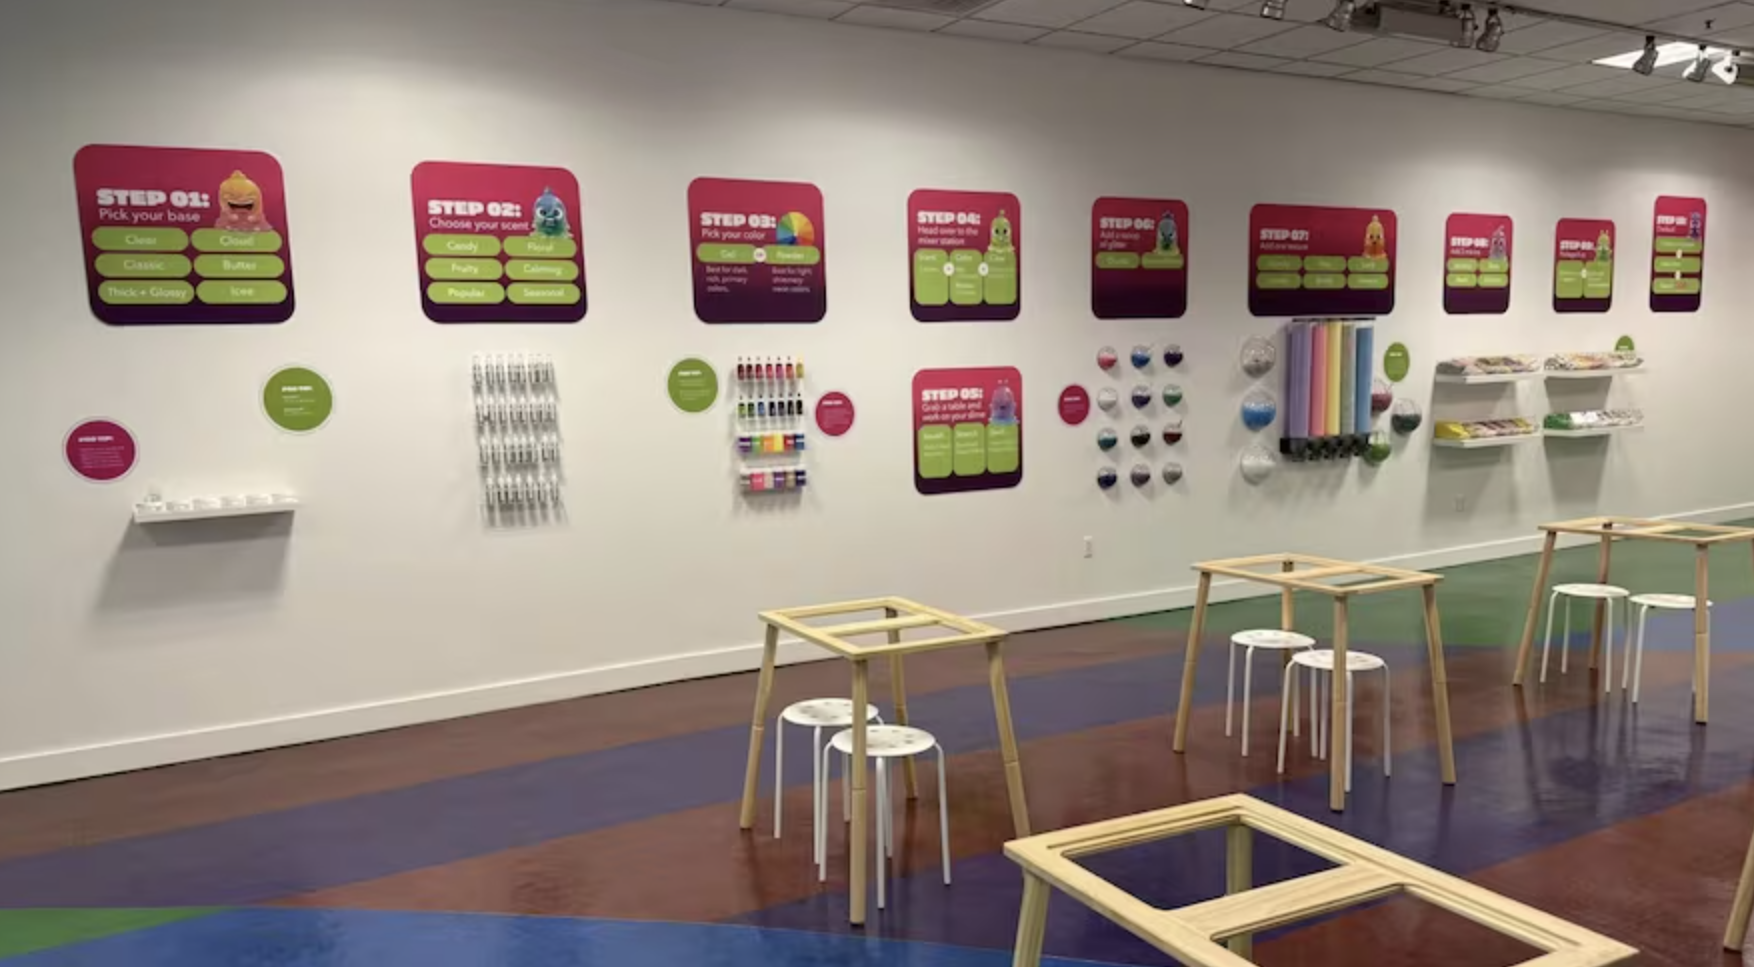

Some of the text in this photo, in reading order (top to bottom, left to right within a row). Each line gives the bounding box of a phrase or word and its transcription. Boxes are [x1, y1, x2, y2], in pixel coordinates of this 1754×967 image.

[97, 188, 211, 208] STEP 01:
[427, 200, 522, 217] STEP 02:
[99, 208, 200, 224] Pick your base
[701, 212, 777, 229] STEP 03:
[917, 211, 981, 225] STEP 04:
[429, 217, 529, 232] Choose your scent
[1100, 217, 1155, 231] STEP 06:
[701, 228, 766, 241] Pick your color
[918, 226, 979, 236] Head over to the
[1260, 228, 1309, 241] STEP 07:
[125, 234, 157, 245] Clear
[220, 235, 254, 246] Cloud
[940, 237, 965, 246] station
[1451, 236, 1473, 247] STEP
[447, 241, 478, 253] Candy
[124, 259, 165, 271] Classic
[223, 259, 257, 271] Butter
[451, 264, 479, 275] Fruity
[524, 263, 563, 276] Calming
[108, 286, 137, 298] Thick
[150, 287, 187, 300] Glossy
[230, 286, 254, 296] Icee
[448, 287, 485, 299] Popular
[922, 387, 984, 402] STEP 05:
[922, 402, 941, 412] Grab
[948, 402, 967, 411] table
[967, 401, 982, 410] and
[922, 412, 940, 421] work
[951, 413, 967, 422] your
[967, 410, 986, 419] slime
